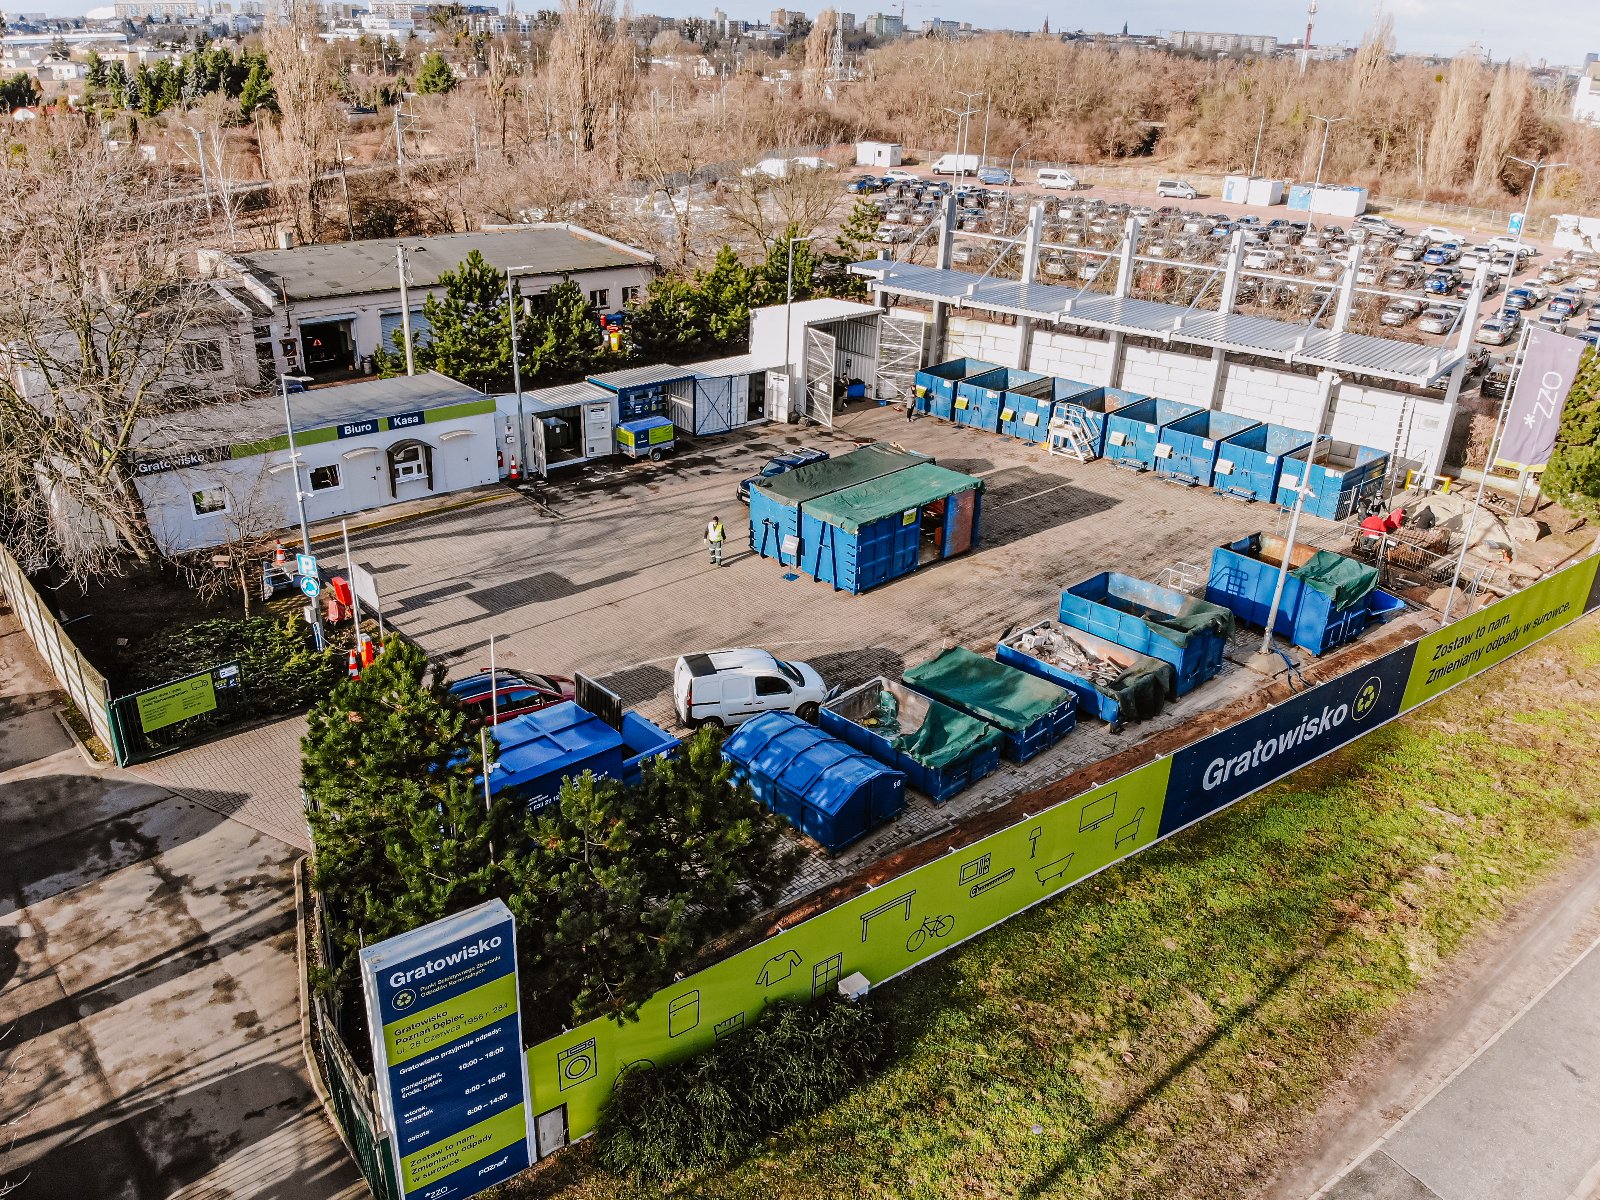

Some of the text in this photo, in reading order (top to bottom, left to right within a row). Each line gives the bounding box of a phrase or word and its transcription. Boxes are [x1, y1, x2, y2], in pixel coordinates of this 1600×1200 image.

[344, 424, 372, 435] Biuro
[394, 416, 418, 426] Kasa
[1425, 602, 1570, 685] Zmieniamy odpady w surowce.
[1432, 614, 1511, 662] Zostaw to nam.
[1202, 704, 1348, 791] Gratowisko
[390, 936, 502, 988] Gratowisko
[394, 1011, 448, 1036] Gratowisko
[396, 1012, 465, 1046] Poznań Dębiec
[410, 1042, 420, 1050] 28
[424, 1024, 461, 1044] Czerwca
[464, 1014, 484, 1026] 1956
[493, 1002, 508, 1014] 284
[400, 1028, 502, 1075] Gratowisko przyjmuje odpady:
[458, 1058, 478, 1070] 10:00
[485, 1046, 504, 1059] 18:00
[465, 1084, 480, 1095] 8:00
[488, 1072, 506, 1084] 16:00
[405, 1108, 434, 1125] czwartek
[467, 1104, 482, 1116] 8:00
[490, 1092, 508, 1105] 14:00
[408, 1130, 430, 1143] sobota
[410, 1148, 443, 1167] Zostaw
[456, 1134, 477, 1146] nam.
[411, 1133, 493, 1175] Zmieniamy odpady
[422, 1159, 461, 1179] surowce.
